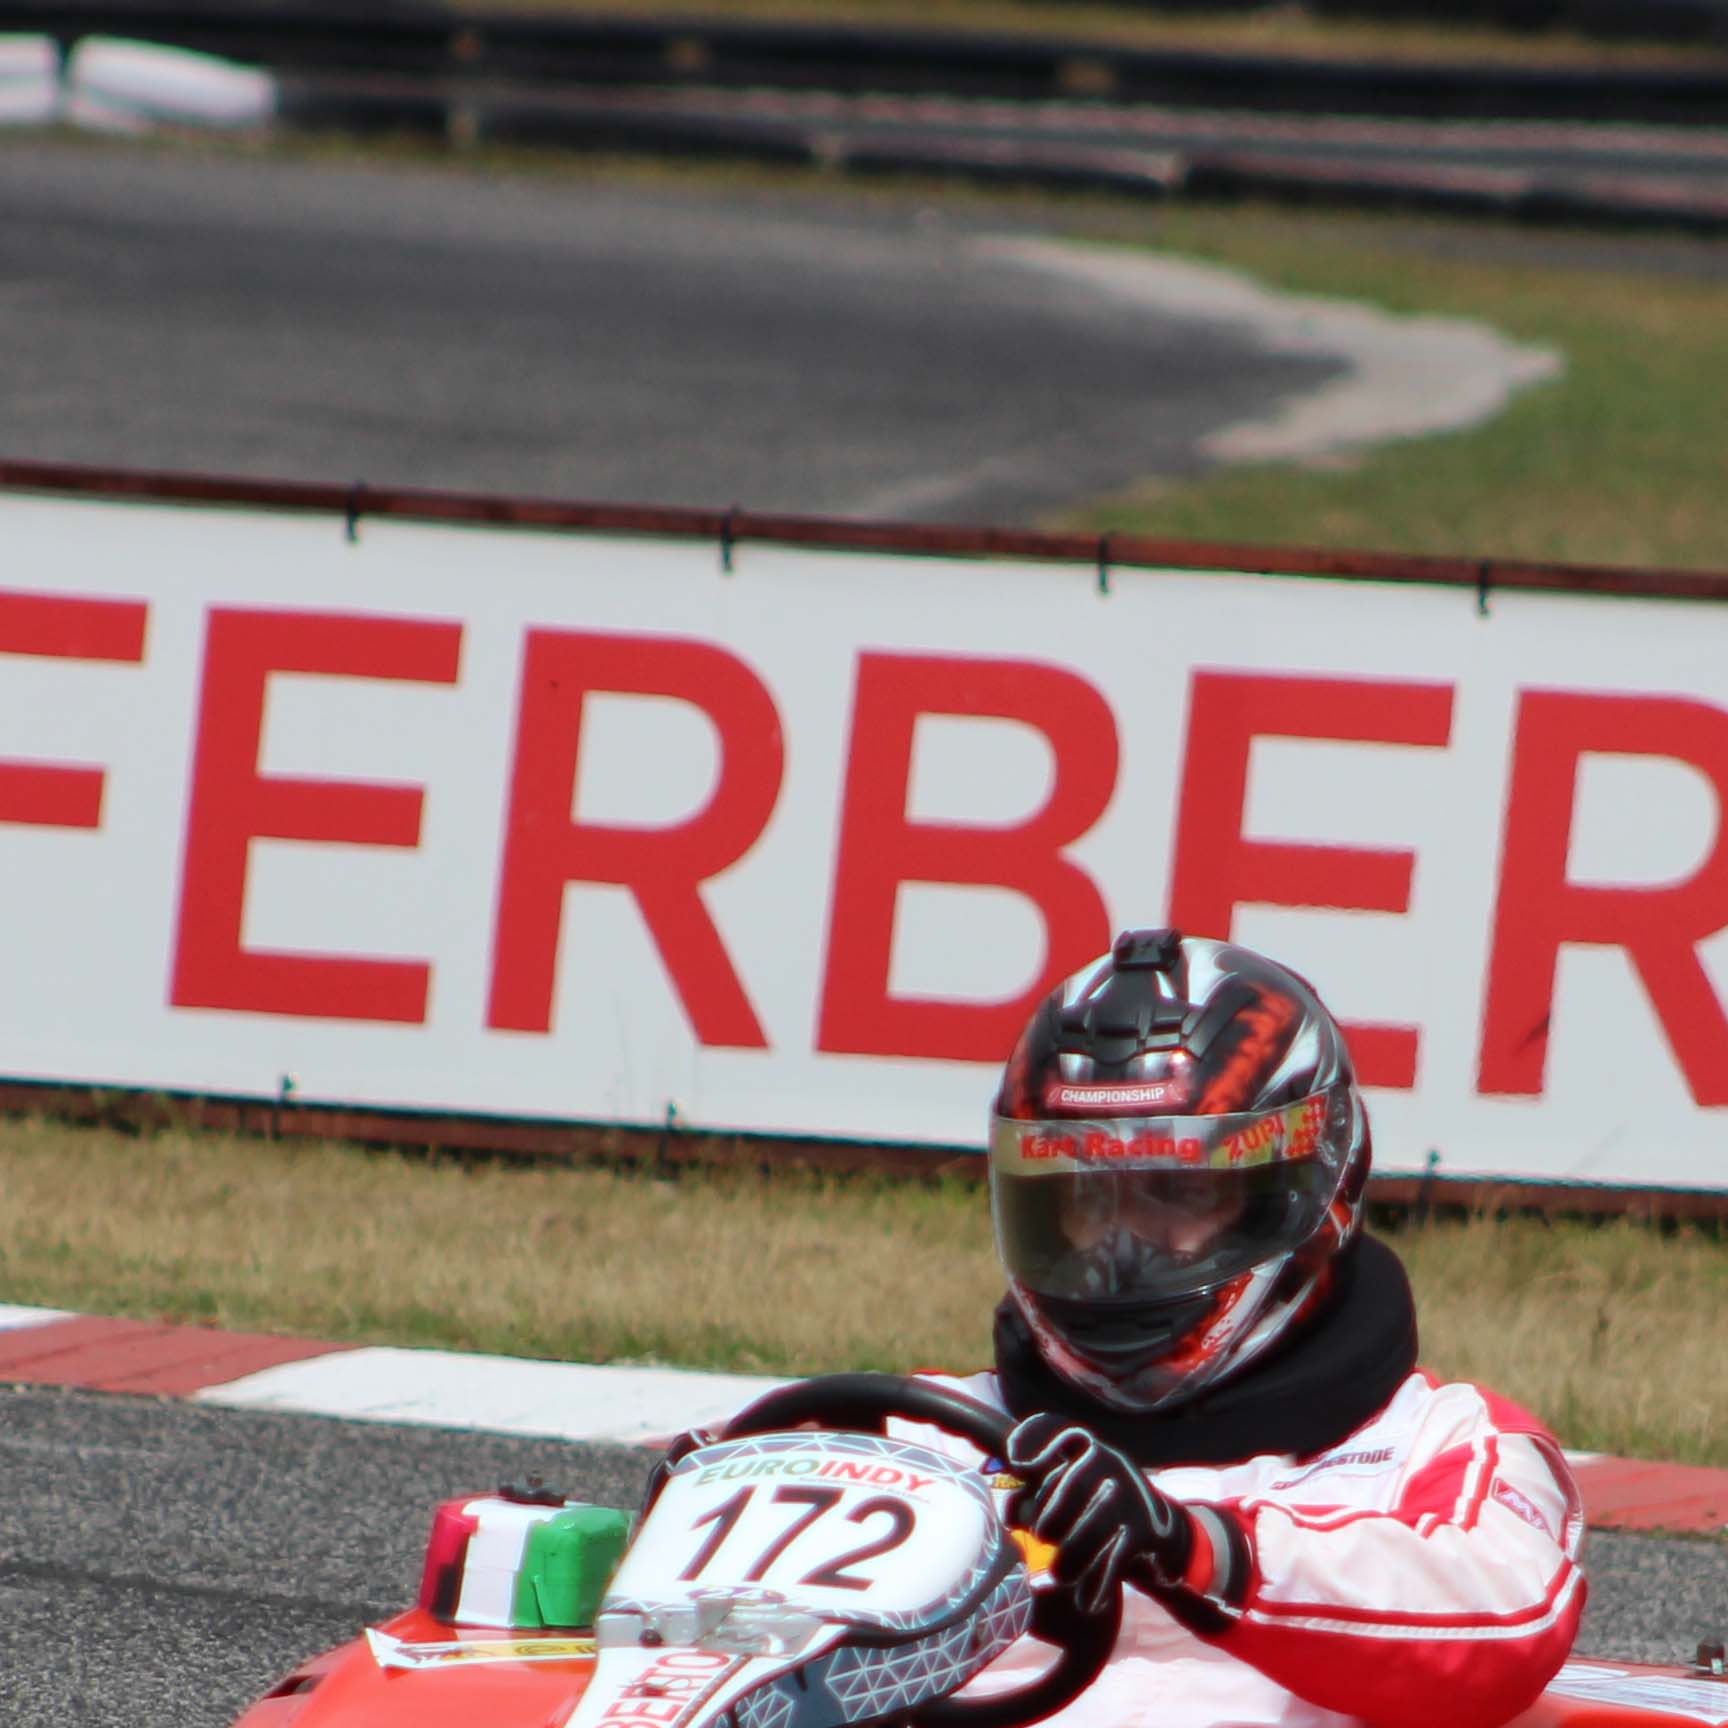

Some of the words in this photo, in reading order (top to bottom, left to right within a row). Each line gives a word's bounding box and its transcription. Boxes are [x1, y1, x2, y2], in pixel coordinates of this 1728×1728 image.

[1060, 1086, 1165, 1105] CHAMPIONSHIP
[1021, 1133, 1078, 1160] Kart
[1083, 1129, 1202, 1164] Racing
[693, 1458, 937, 1492] EUROINDY
[676, 1484, 917, 1592] 172
